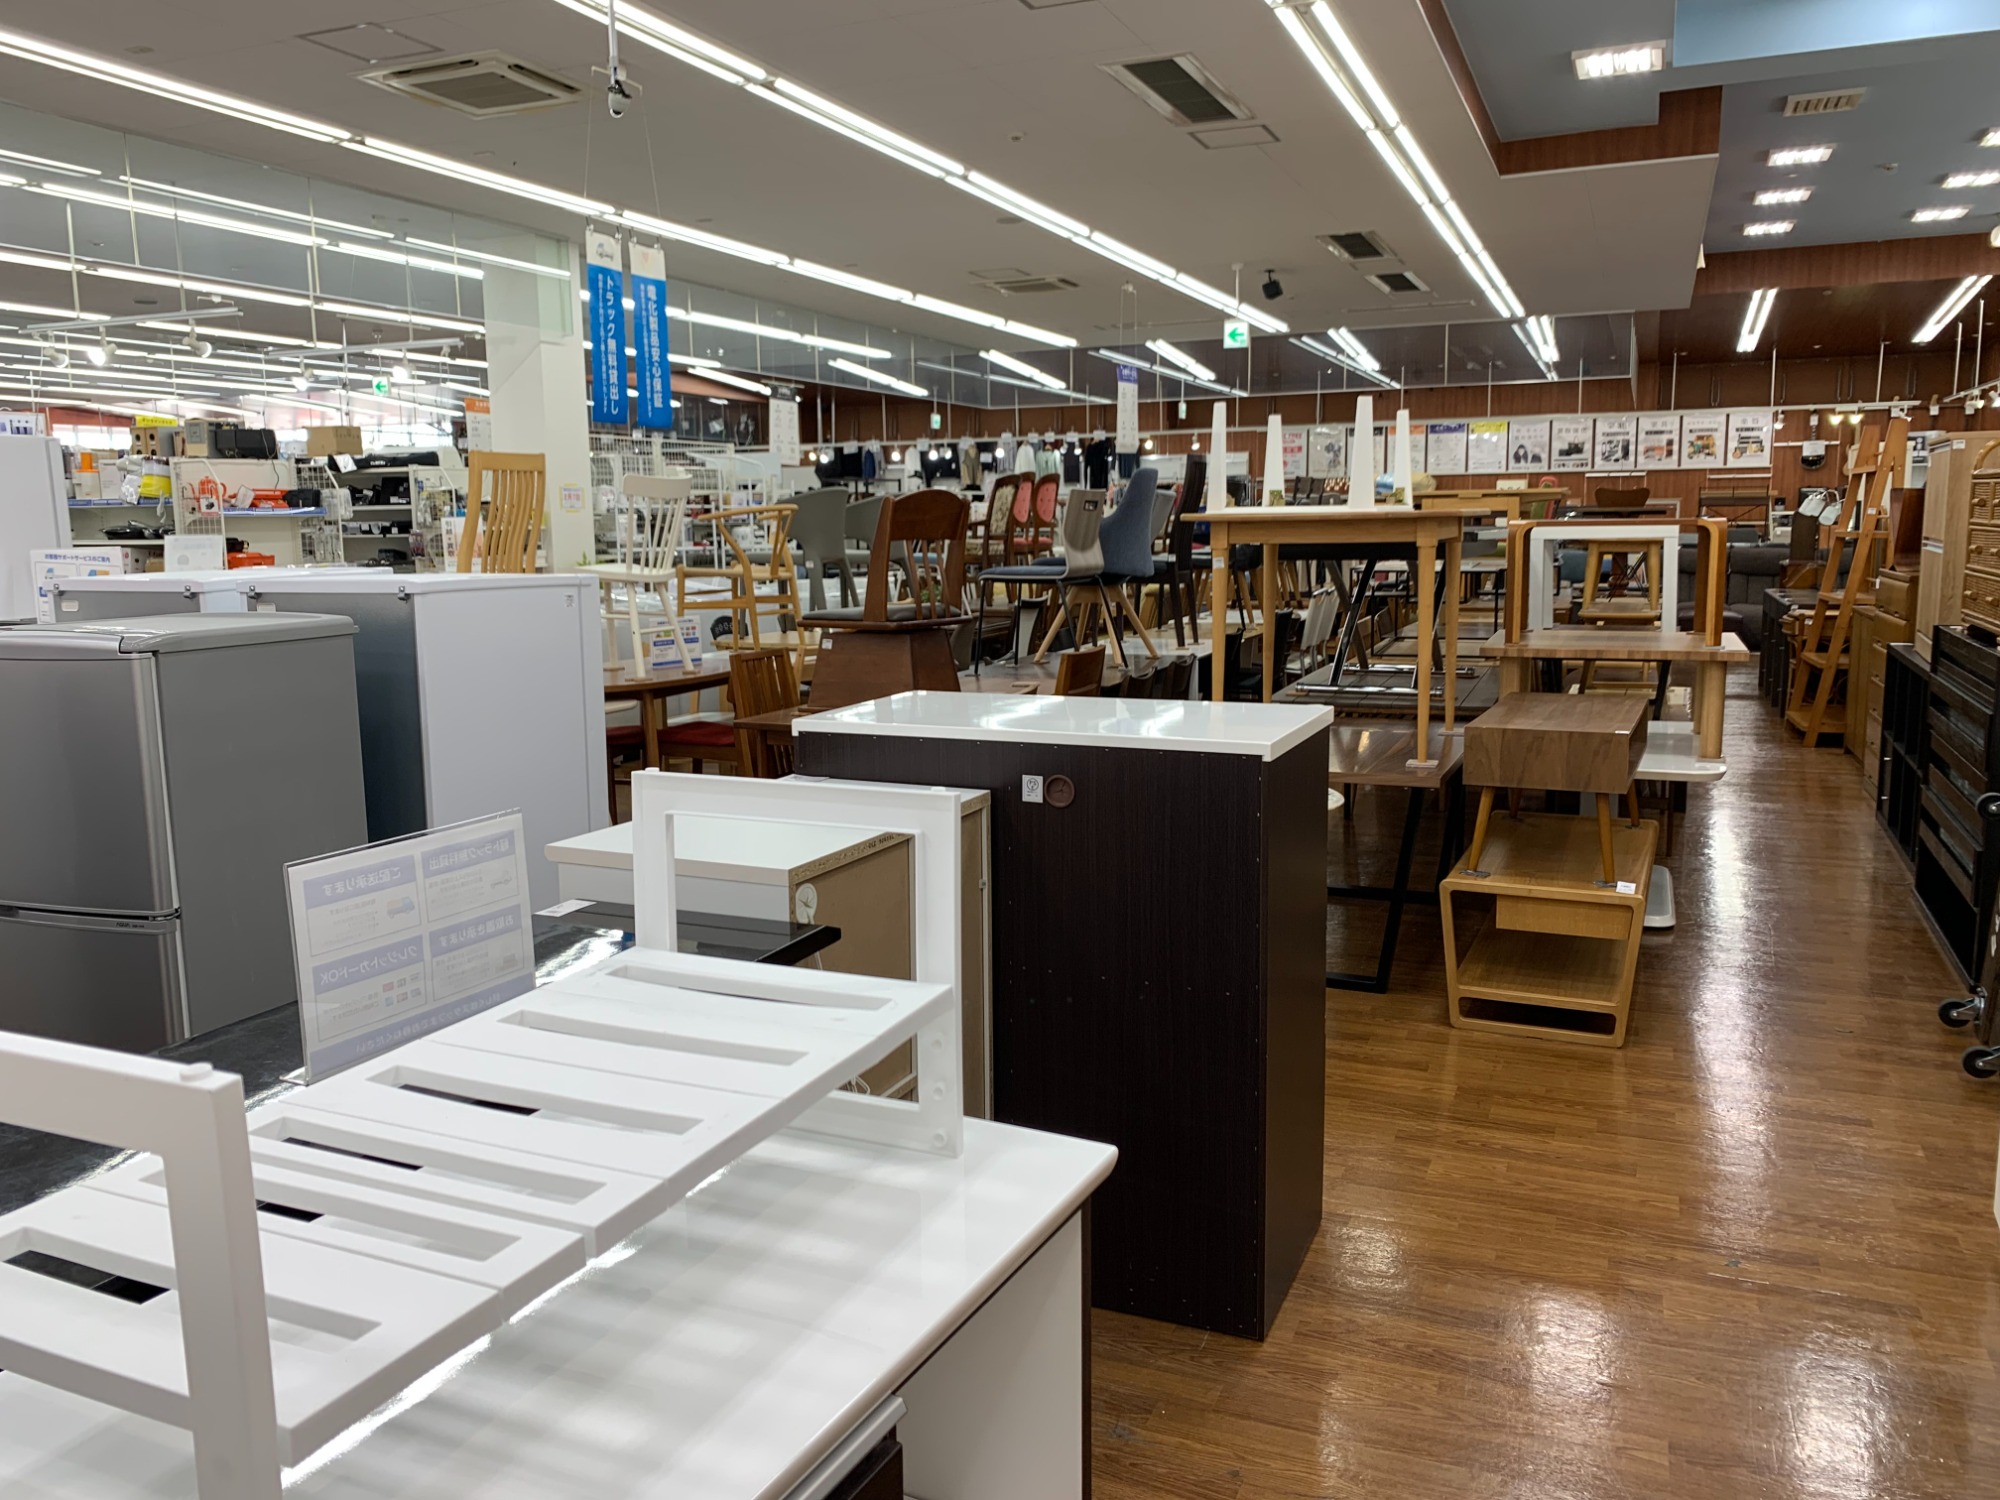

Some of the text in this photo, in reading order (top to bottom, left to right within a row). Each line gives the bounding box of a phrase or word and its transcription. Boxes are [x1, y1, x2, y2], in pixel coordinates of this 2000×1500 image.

[606, 273, 619, 415] トラック無料貸出し
[647, 283, 664, 408] 電化製品安心保証
